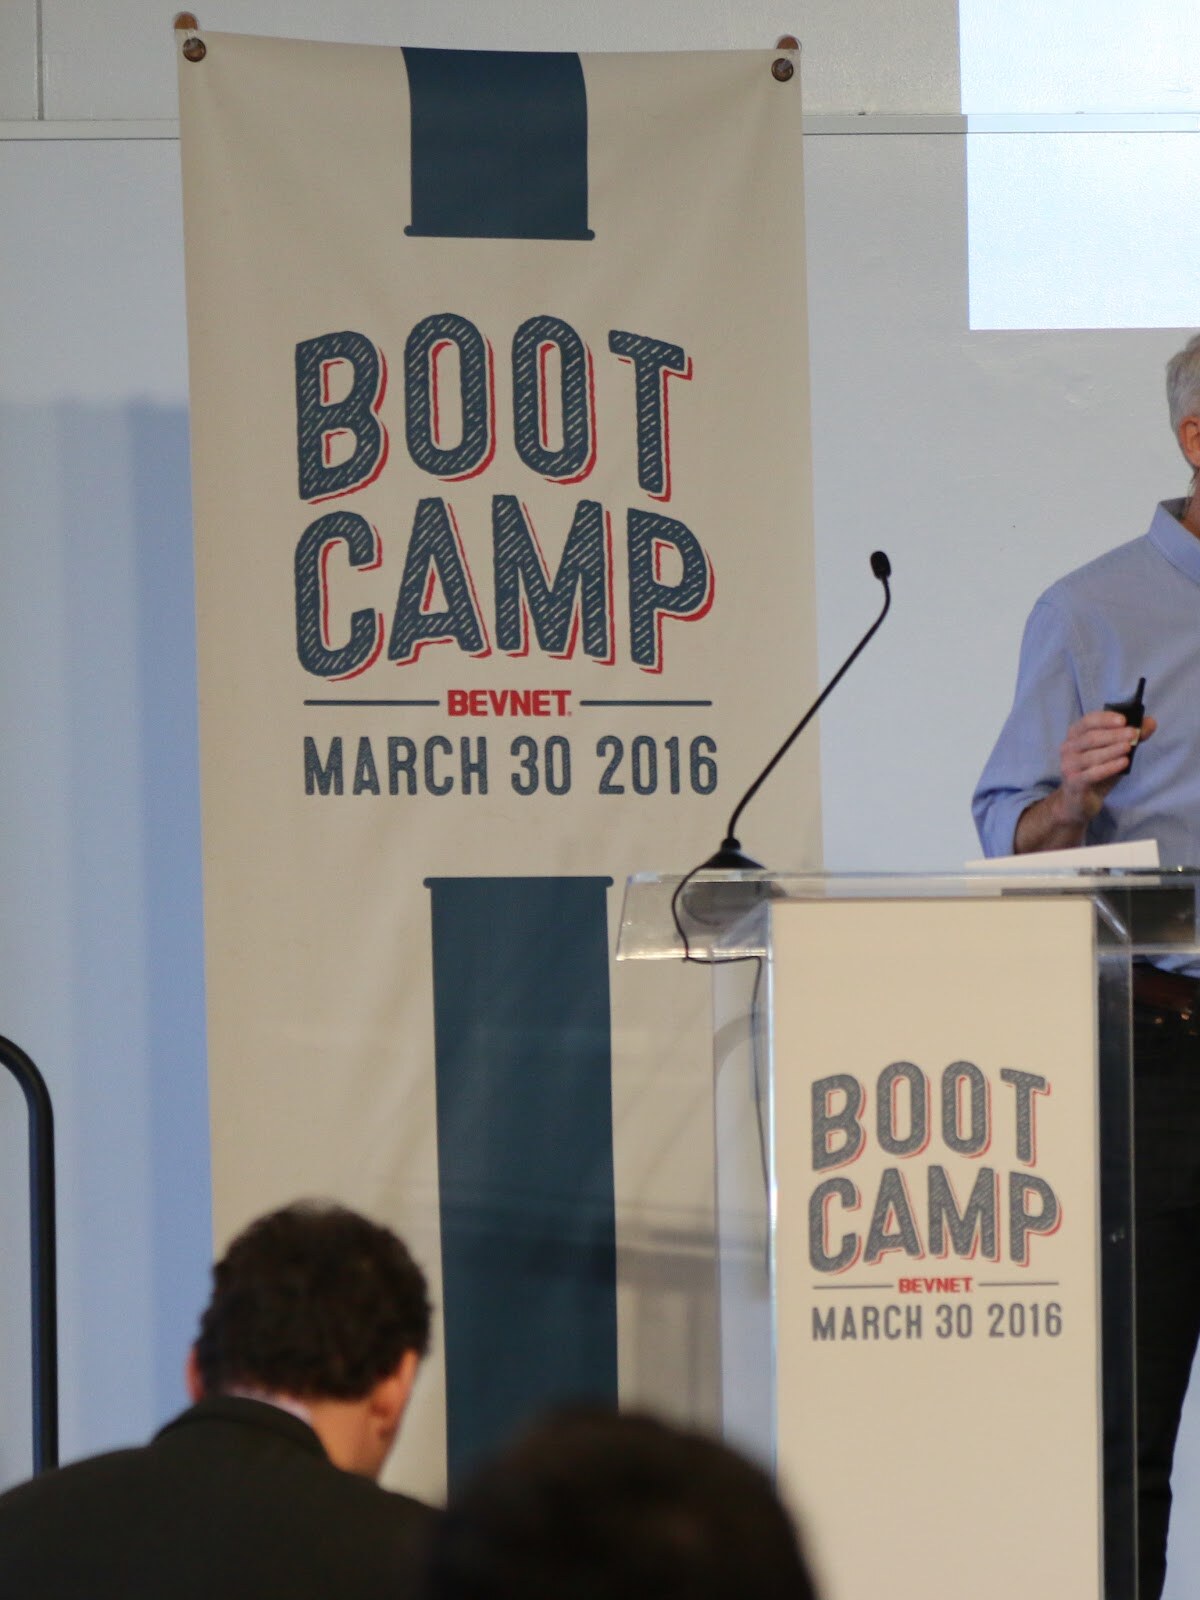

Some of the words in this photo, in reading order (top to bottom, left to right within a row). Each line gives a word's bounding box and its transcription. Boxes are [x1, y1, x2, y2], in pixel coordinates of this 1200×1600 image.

[295, 312, 693, 504] BOOT
[294, 494, 715, 682] CAMP
[447, 689, 571, 716] BEVNET
[303, 735, 488, 796] MARCH
[510, 735, 571, 796] 30
[596, 735, 718, 796] 2016
[811, 1061, 1050, 1174] BOOT
[808, 1165, 1062, 1276] CAMP
[812, 1304, 922, 1341] MARCH
[936, 1304, 973, 1339] 30
[988, 1303, 1063, 1338] 2016
[898, 1276, 973, 1294] BEVNET
